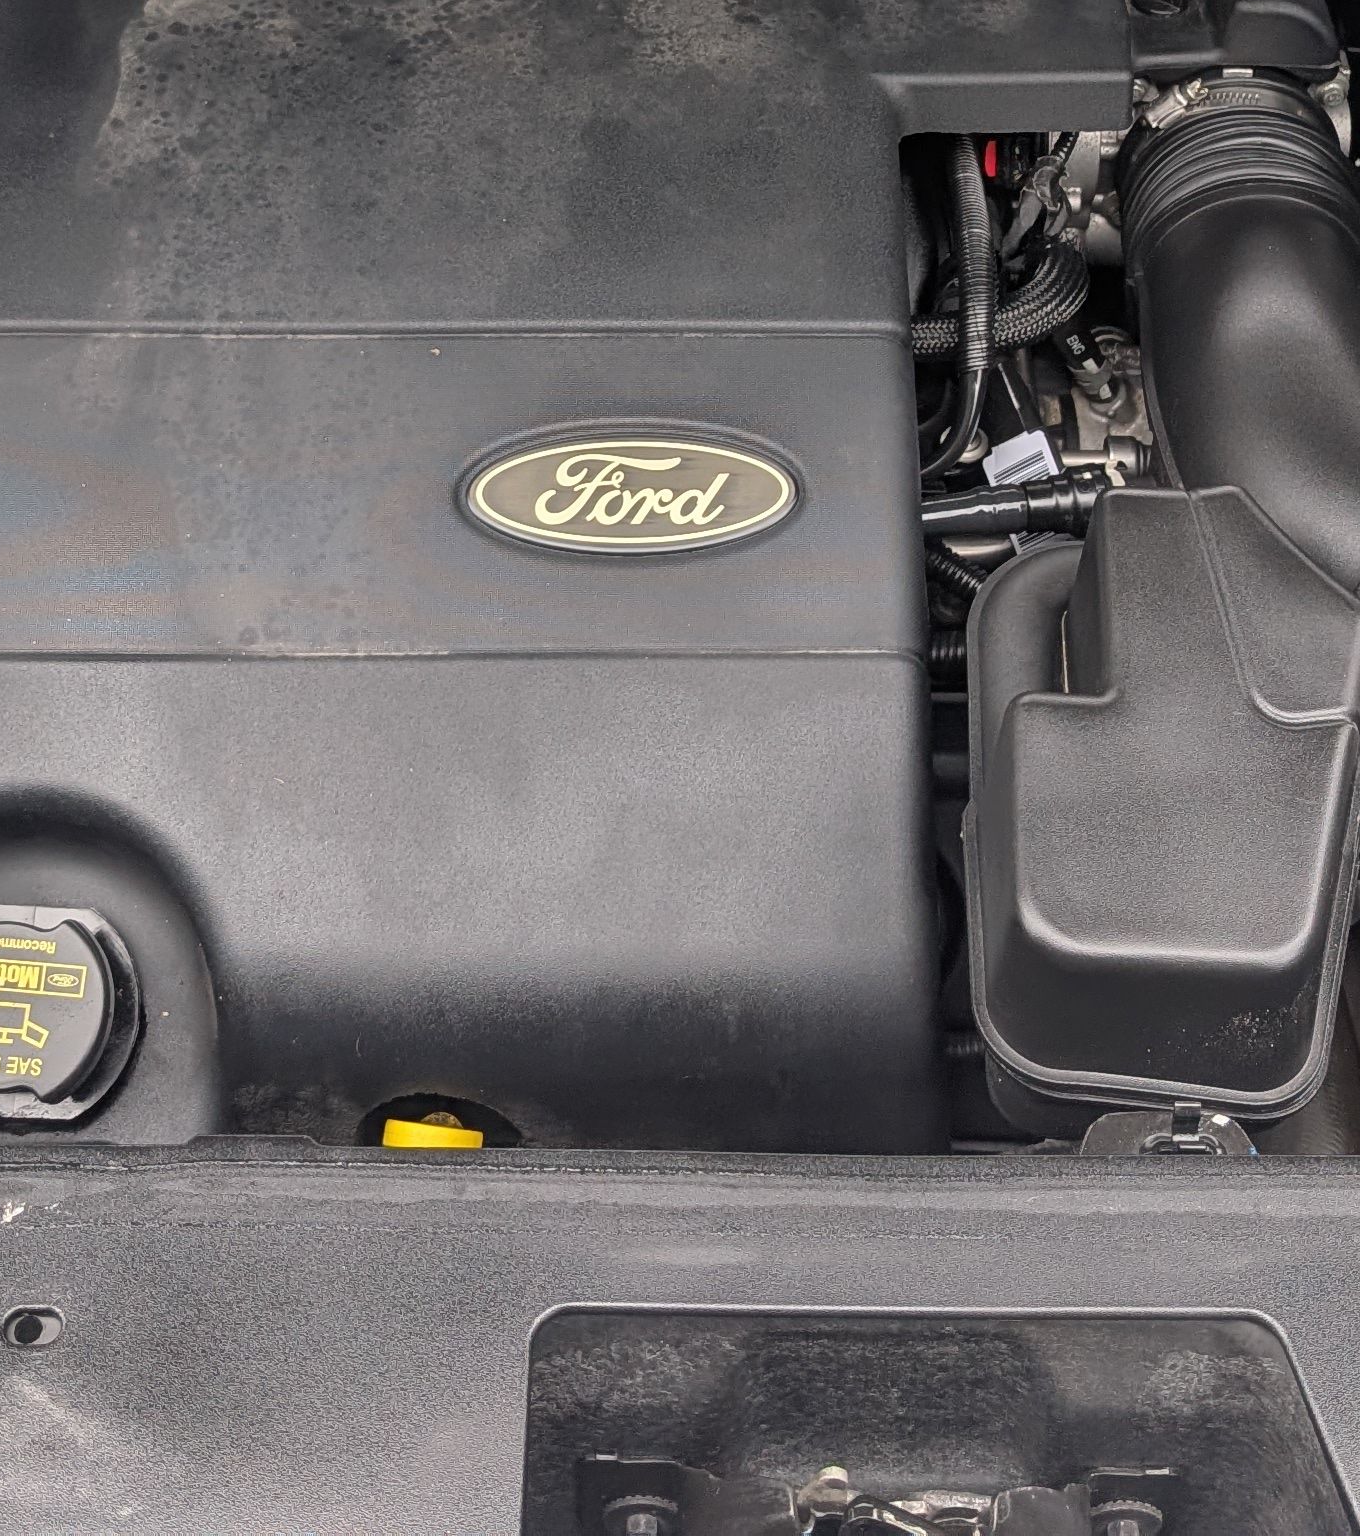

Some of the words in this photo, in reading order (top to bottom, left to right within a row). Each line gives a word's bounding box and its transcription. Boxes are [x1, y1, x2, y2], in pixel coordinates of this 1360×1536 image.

[1066, 334, 1086, 355] ENG
[534, 453, 730, 526] Ford
[6, 1056, 43, 1076] SAE
